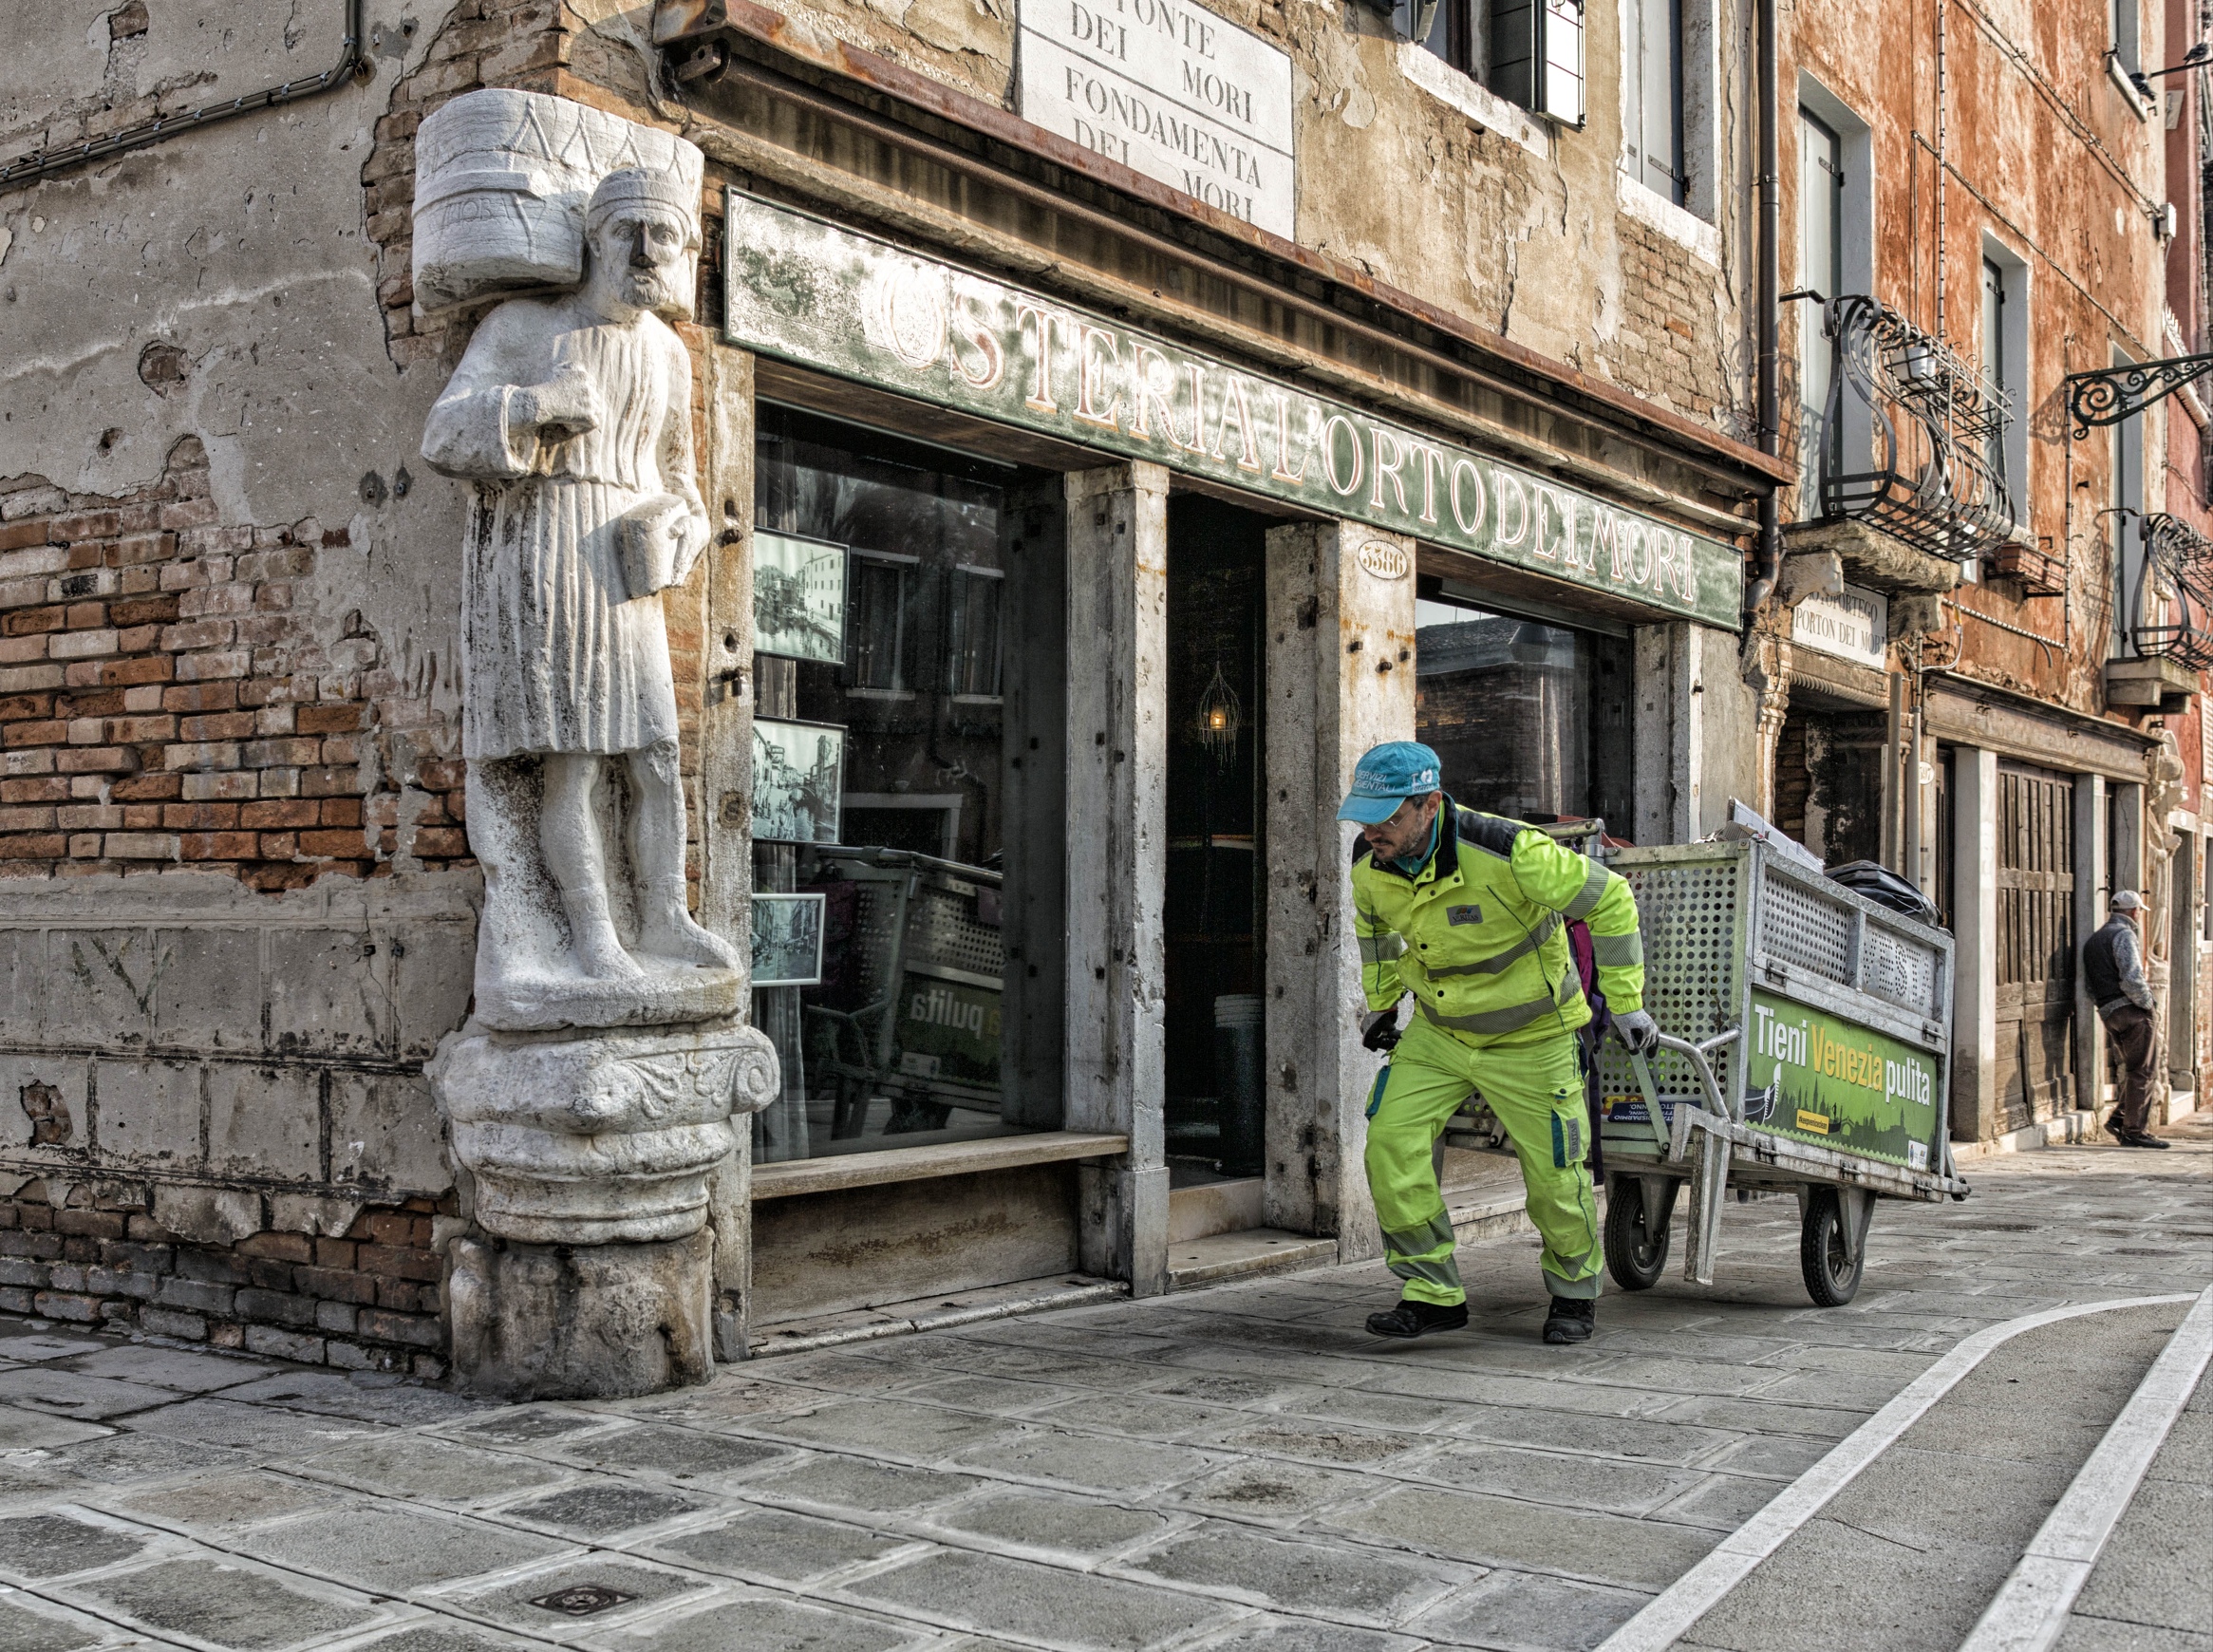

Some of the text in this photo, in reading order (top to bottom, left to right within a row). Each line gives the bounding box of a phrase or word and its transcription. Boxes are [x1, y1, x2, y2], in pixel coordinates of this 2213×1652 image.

[1071, 1, 1251, 123] DEI MORI
[1116, 0, 1215, 60] ONTE
[1064, 66, 1263, 190] FONDAMENTA
[1074, 118, 1253, 224] DEI MORI
[879, 266, 1696, 603] OSTERIA L'ORTO DEI MORI
[1362, 545, 1403, 575] 3386
[1794, 607, 1885, 656] PORTON DEI MORI
[1356, 770, 1387, 782] SERVIZI
[1754, 1004, 1930, 1106] Tieni Venezia pulita
